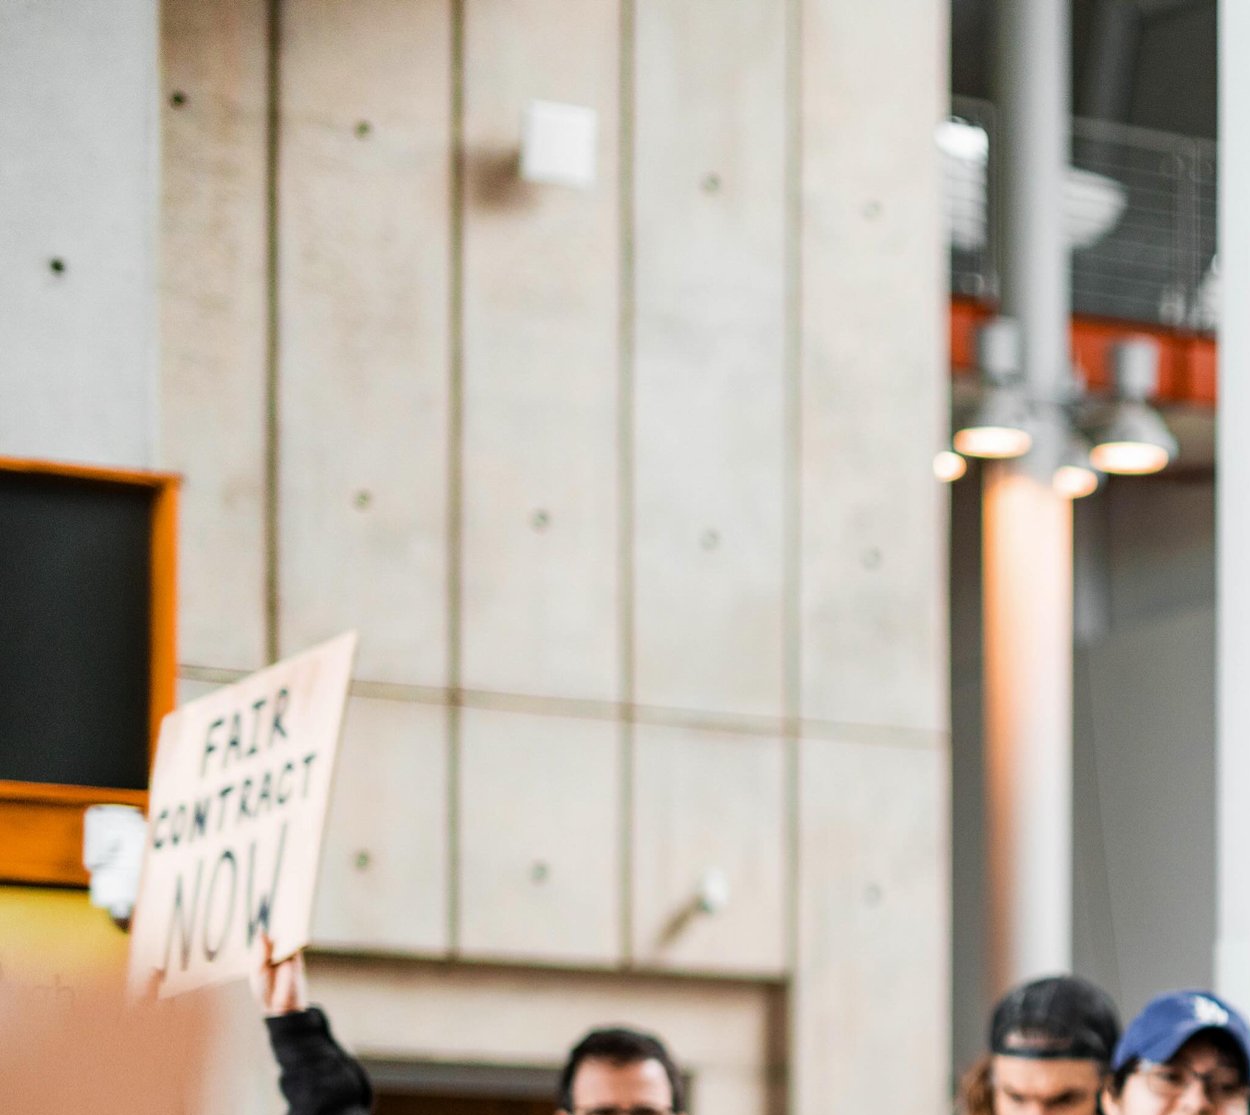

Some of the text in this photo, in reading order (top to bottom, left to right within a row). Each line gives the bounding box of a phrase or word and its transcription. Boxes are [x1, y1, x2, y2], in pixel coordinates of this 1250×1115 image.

[202, 687, 290, 777] FAIR
[153, 753, 316, 849] CONTRACT
[160, 819, 288, 974] NOW
